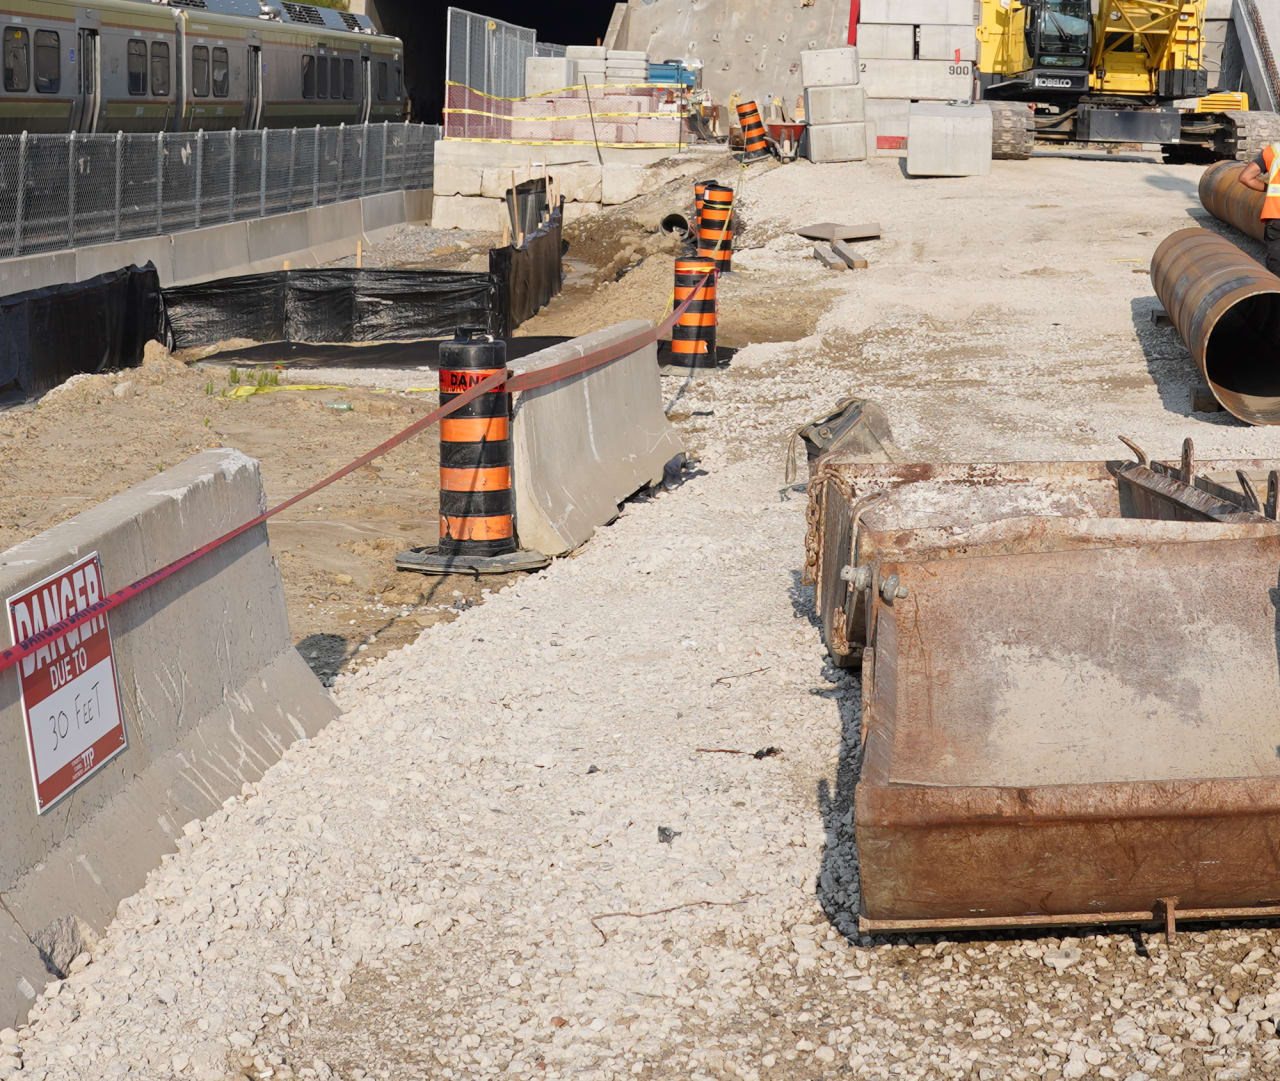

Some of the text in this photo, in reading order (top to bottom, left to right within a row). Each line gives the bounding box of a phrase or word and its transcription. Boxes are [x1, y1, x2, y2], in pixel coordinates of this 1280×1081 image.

[948, 66, 969, 76] 900
[1035, 77, 1072, 88] KOBELCO
[15, 563, 105, 678] DANGER
[49, 647, 88, 691] DUE TO
[49, 681, 102, 752] 30 FEET
